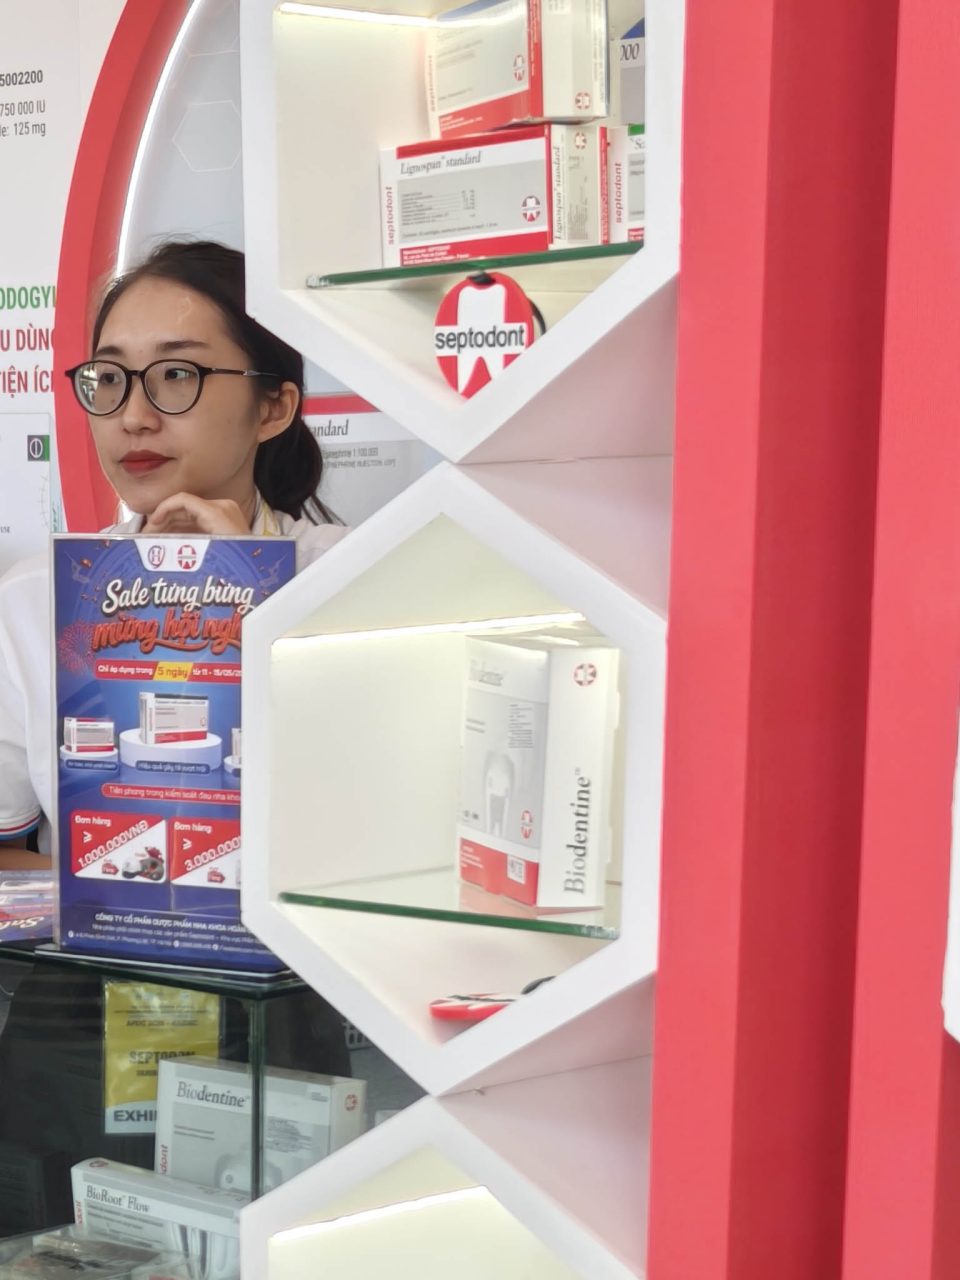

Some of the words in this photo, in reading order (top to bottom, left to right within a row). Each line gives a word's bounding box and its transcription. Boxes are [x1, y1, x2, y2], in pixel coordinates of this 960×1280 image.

[0, 102, 16, 117] 750
[17, 100, 35, 115] 000
[36, 99, 46, 114] IU
[13, 121, 30, 136] 125
[31, 123, 46, 137] mg
[435, 323, 525, 354] septodont
[102, 577, 150, 614] Sale
[203, 575, 255, 615] bừng
[157, 666, 164, 675] 5
[166, 668, 188, 679] ngày
[92, 816, 111, 827] hàng
[192, 823, 212, 834] hàng
[177, 1080, 245, 1109] Biodentine
[127, 1196, 150, 1213] Flow
